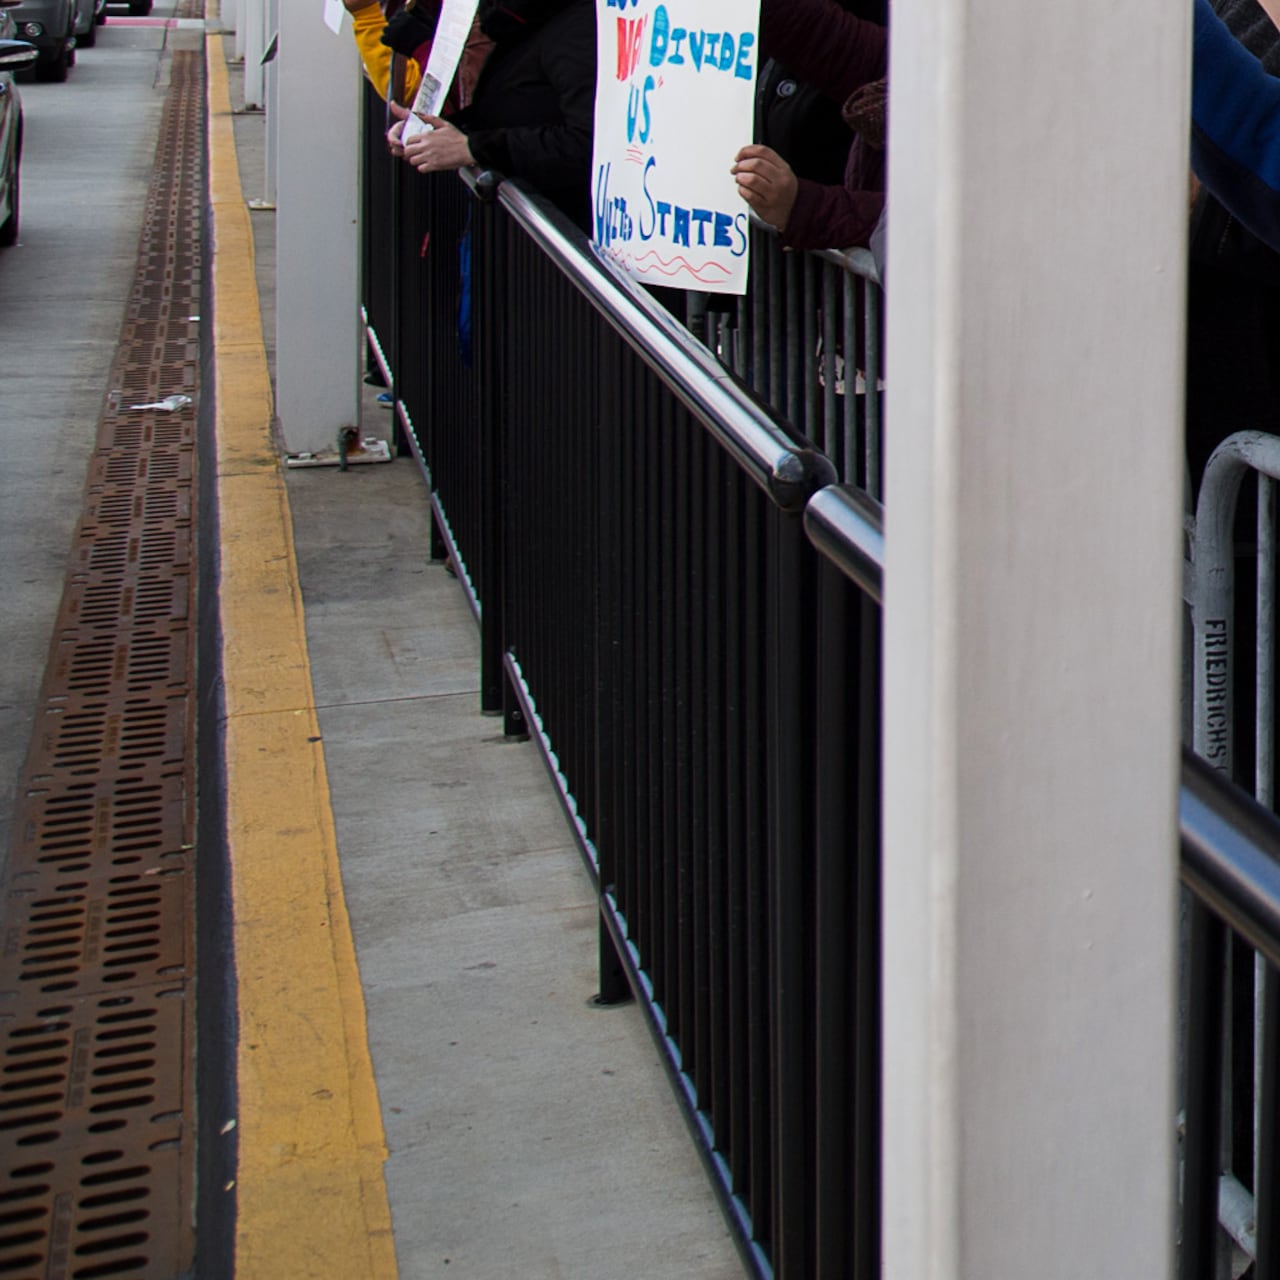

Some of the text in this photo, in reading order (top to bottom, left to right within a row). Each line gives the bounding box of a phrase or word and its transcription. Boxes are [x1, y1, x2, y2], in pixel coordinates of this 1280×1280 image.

[649, 4, 755, 81] DIVIDE
[639, 156, 748, 257] STATES
[1204, 619, 1228, 760] FRIEDRICHS
